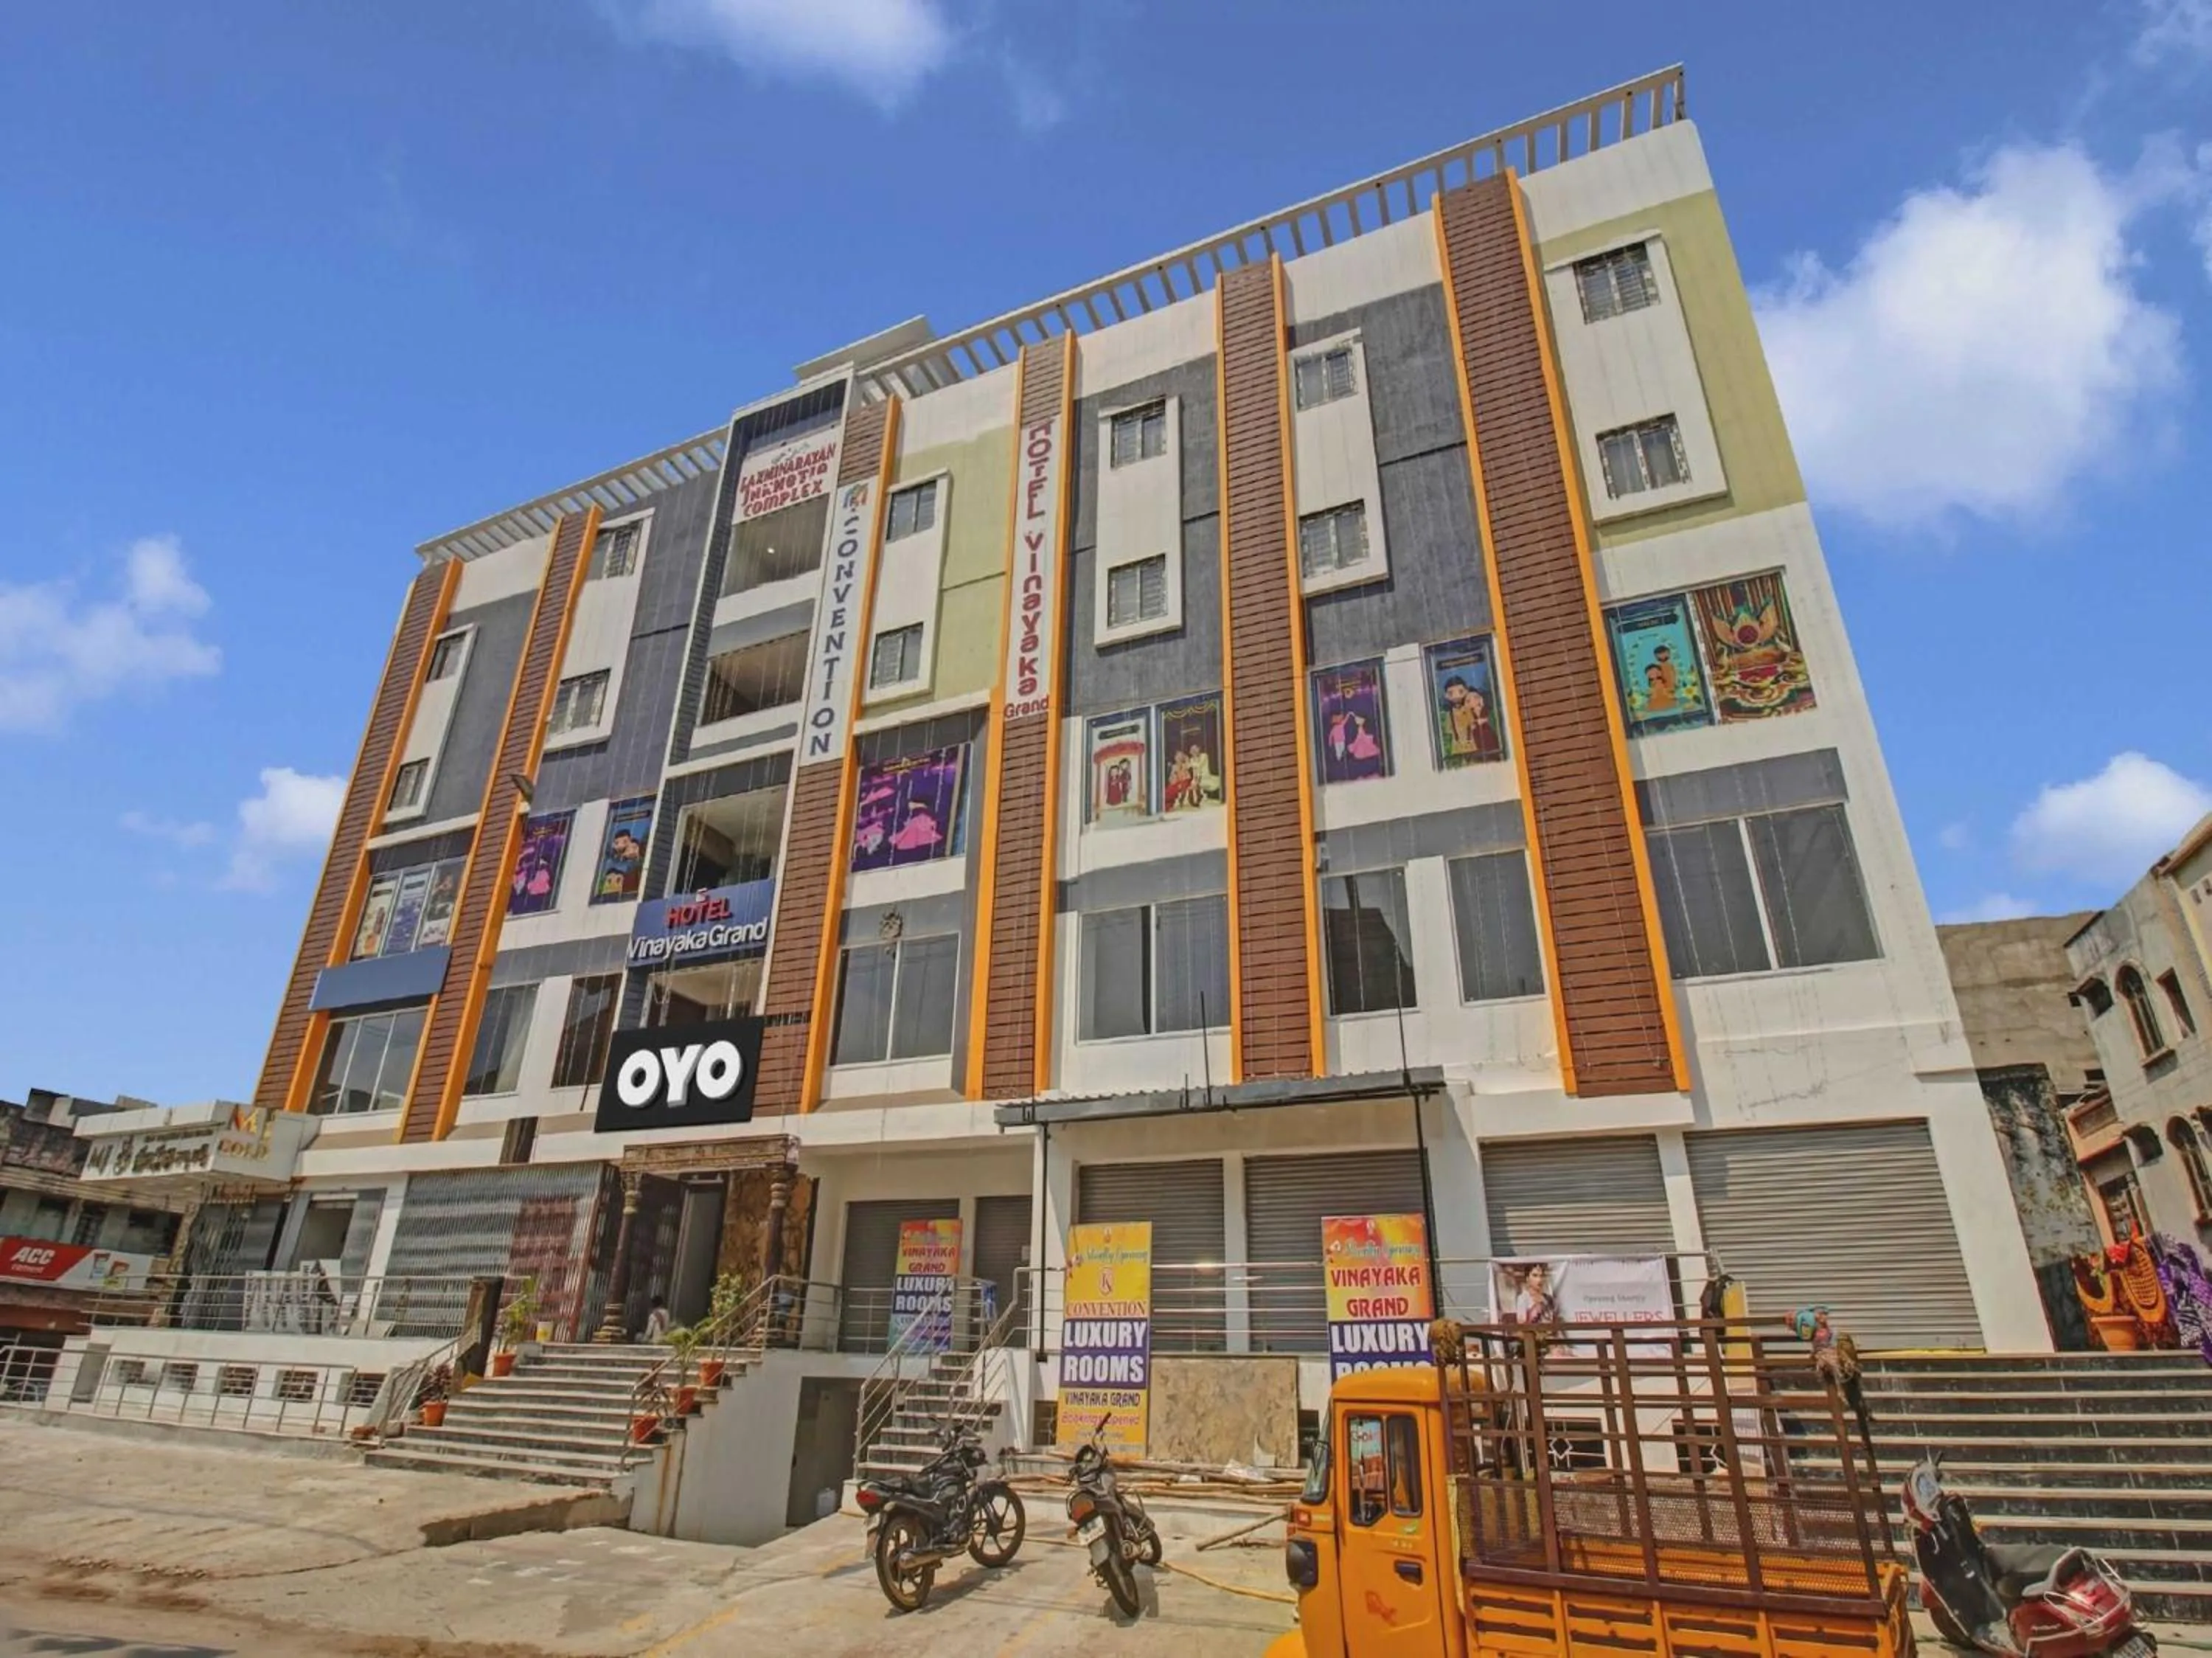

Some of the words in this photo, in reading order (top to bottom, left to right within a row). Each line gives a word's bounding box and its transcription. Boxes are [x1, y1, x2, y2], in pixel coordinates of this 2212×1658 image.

[743, 479, 822, 517] COMPLEX
[810, 516, 859, 756] CONVENTION
[1004, 694, 1049, 718] Grand
[667, 897, 732, 927] HOTEL
[627, 929, 706, 959] Vinayaka
[709, 917, 768, 947] Grand
[617, 1040, 742, 1107] OYO
[10, 1246, 55, 1265] ACC
[908, 1262, 946, 1273] GRAND
[896, 1277, 953, 1292] LUXURY
[1330, 1266, 1421, 1288] VINAYAKA
[894, 1294, 952, 1312] ROOMS
[1066, 1301, 1147, 1317] CONVENTION
[1346, 1297, 1409, 1318] GRAND
[1064, 1321, 1147, 1348] LUXURY
[1331, 1323, 1431, 1353] LUXURY
[1064, 1355, 1144, 1382] ROOMS
[1065, 1392, 1107, 1407] VINAYAKA
[1110, 1392, 1141, 1408] GRAND
